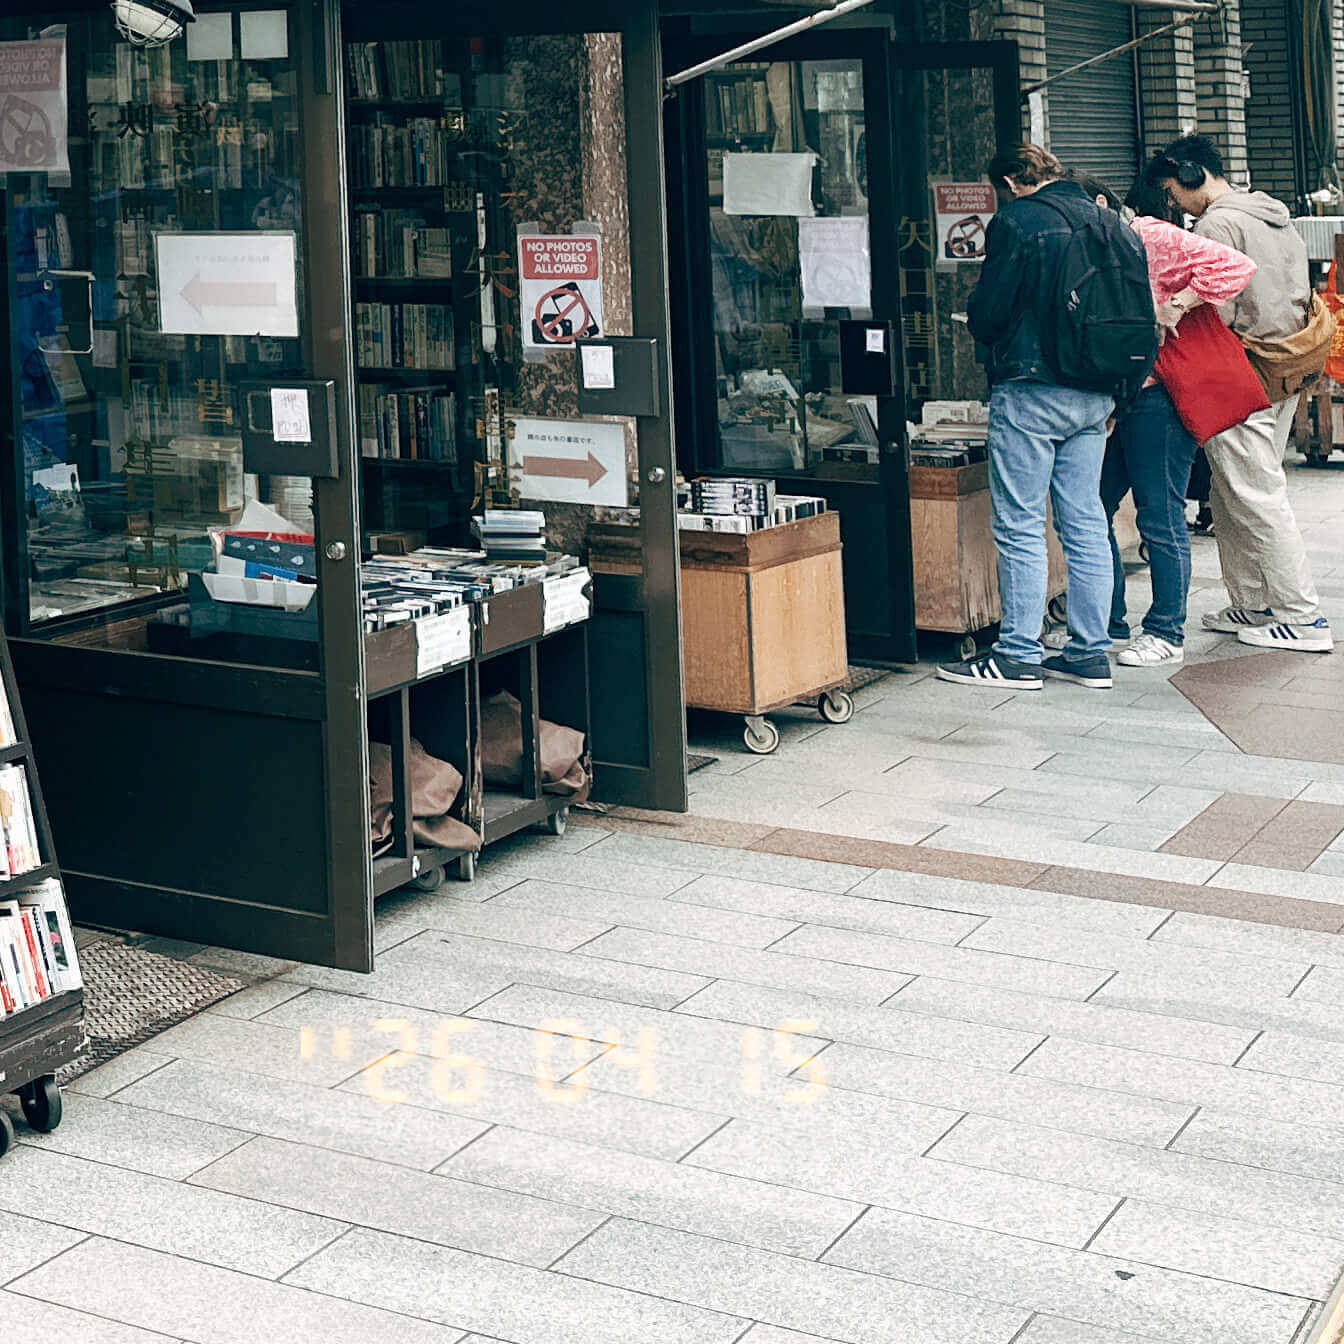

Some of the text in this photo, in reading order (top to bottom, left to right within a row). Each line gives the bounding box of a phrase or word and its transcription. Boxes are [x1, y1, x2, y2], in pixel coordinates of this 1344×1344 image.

[526, 242, 593, 252] NO PHOTOS
[534, 253, 587, 263] OR VIDEO
[534, 263, 588, 274] ALLOWED
